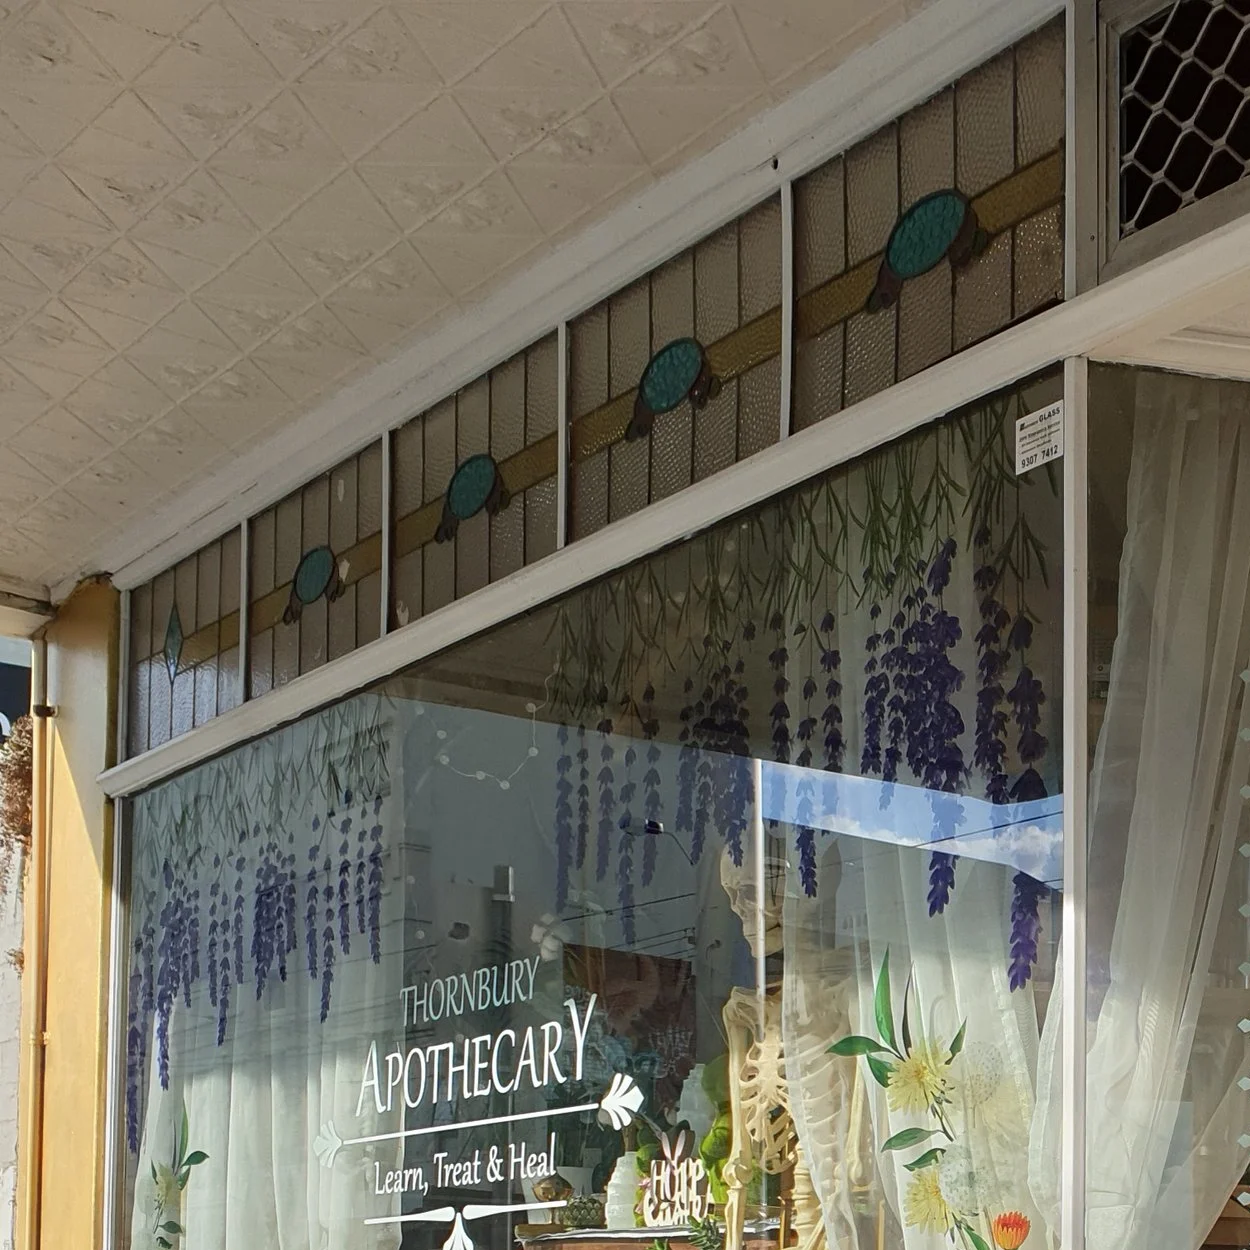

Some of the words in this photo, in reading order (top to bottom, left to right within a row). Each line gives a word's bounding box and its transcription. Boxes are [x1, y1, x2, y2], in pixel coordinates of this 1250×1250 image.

[1039, 407, 1060, 422] GLASS
[1041, 445, 1058, 459] 7412
[400, 955, 541, 1027] THORNBURY
[355, 993, 598, 1117] APOTHECARY
[374, 1161, 429, 1196] Learn,
[433, 1152, 481, 1190] Treat
[486, 1145, 504, 1182] &
[509, 1132, 557, 1181] Heal
